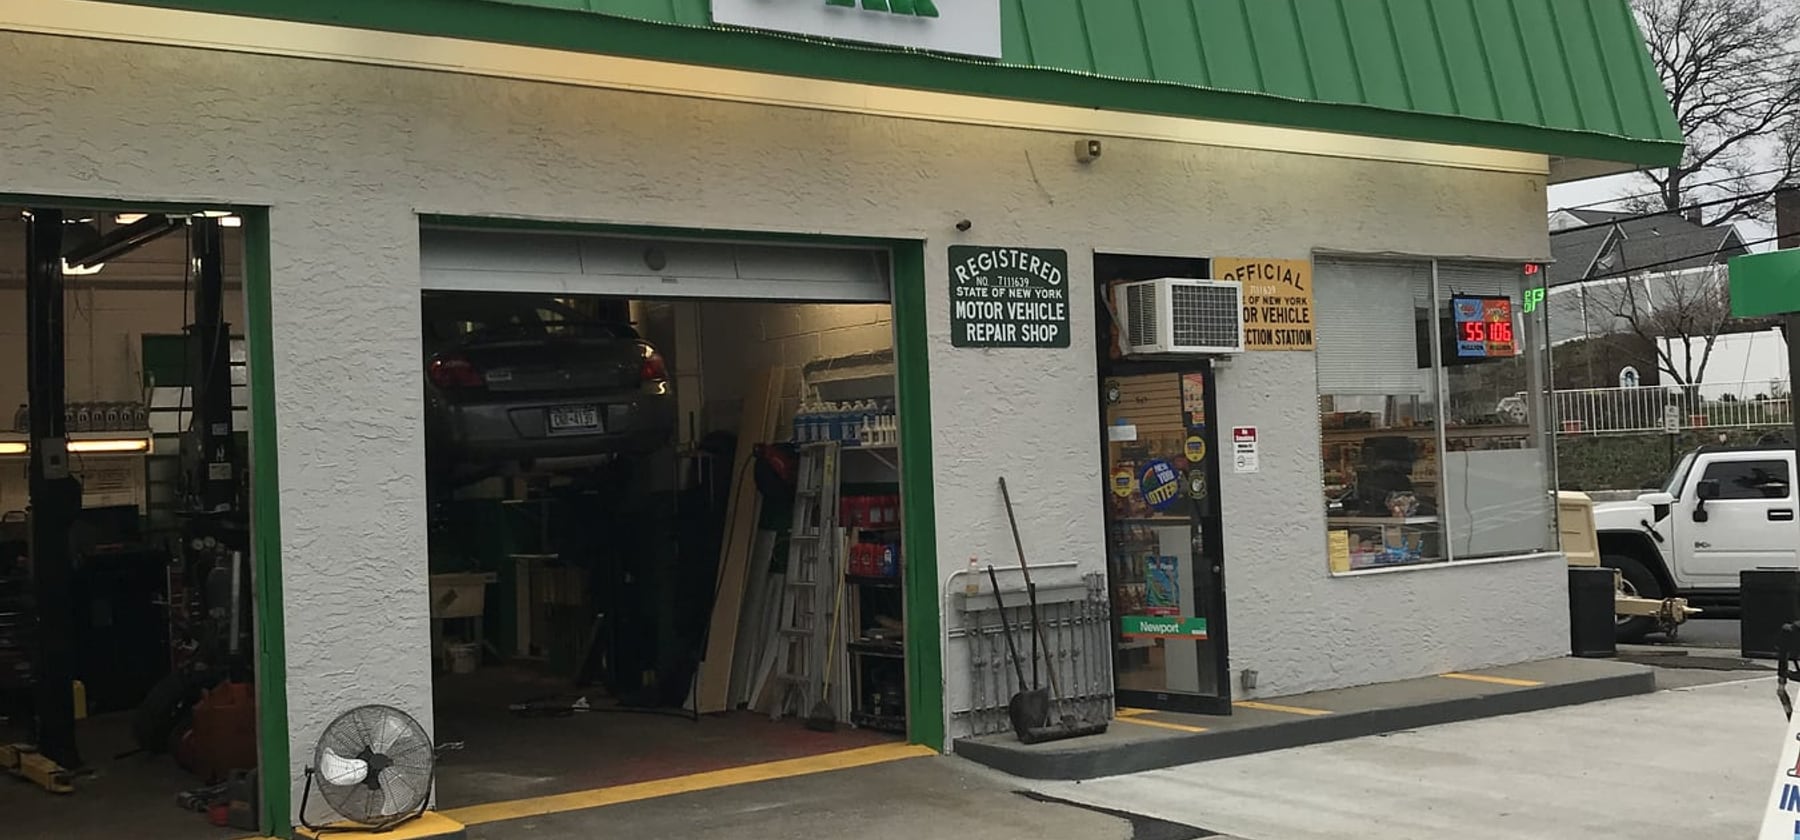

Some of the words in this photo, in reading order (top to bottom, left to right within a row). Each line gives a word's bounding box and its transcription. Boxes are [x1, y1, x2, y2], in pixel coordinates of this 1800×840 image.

[955, 249, 1061, 285] REGISTERED
[956, 286, 988, 297] STATE
[991, 287, 1006, 298] OF
[1009, 288, 1031, 298] NEW
[1034, 289, 1063, 299] YORK
[1248, 296, 1260, 305] OF
[1262, 296, 1282, 305] NEW
[1284, 297, 1307, 306] YORK
[956, 300, 1003, 319] MOTOR
[1006, 301, 1065, 320] VEHICLE
[1261, 307, 1310, 323] VEHICLE
[966, 323, 1016, 341] REPAIR
[1021, 323, 1058, 342] SHOP
[1275, 329, 1312, 345] STATION
[1466, 322, 1484, 341] 55
[1489, 322, 1511, 341] 106
[1140, 621, 1180, 634] Newport
